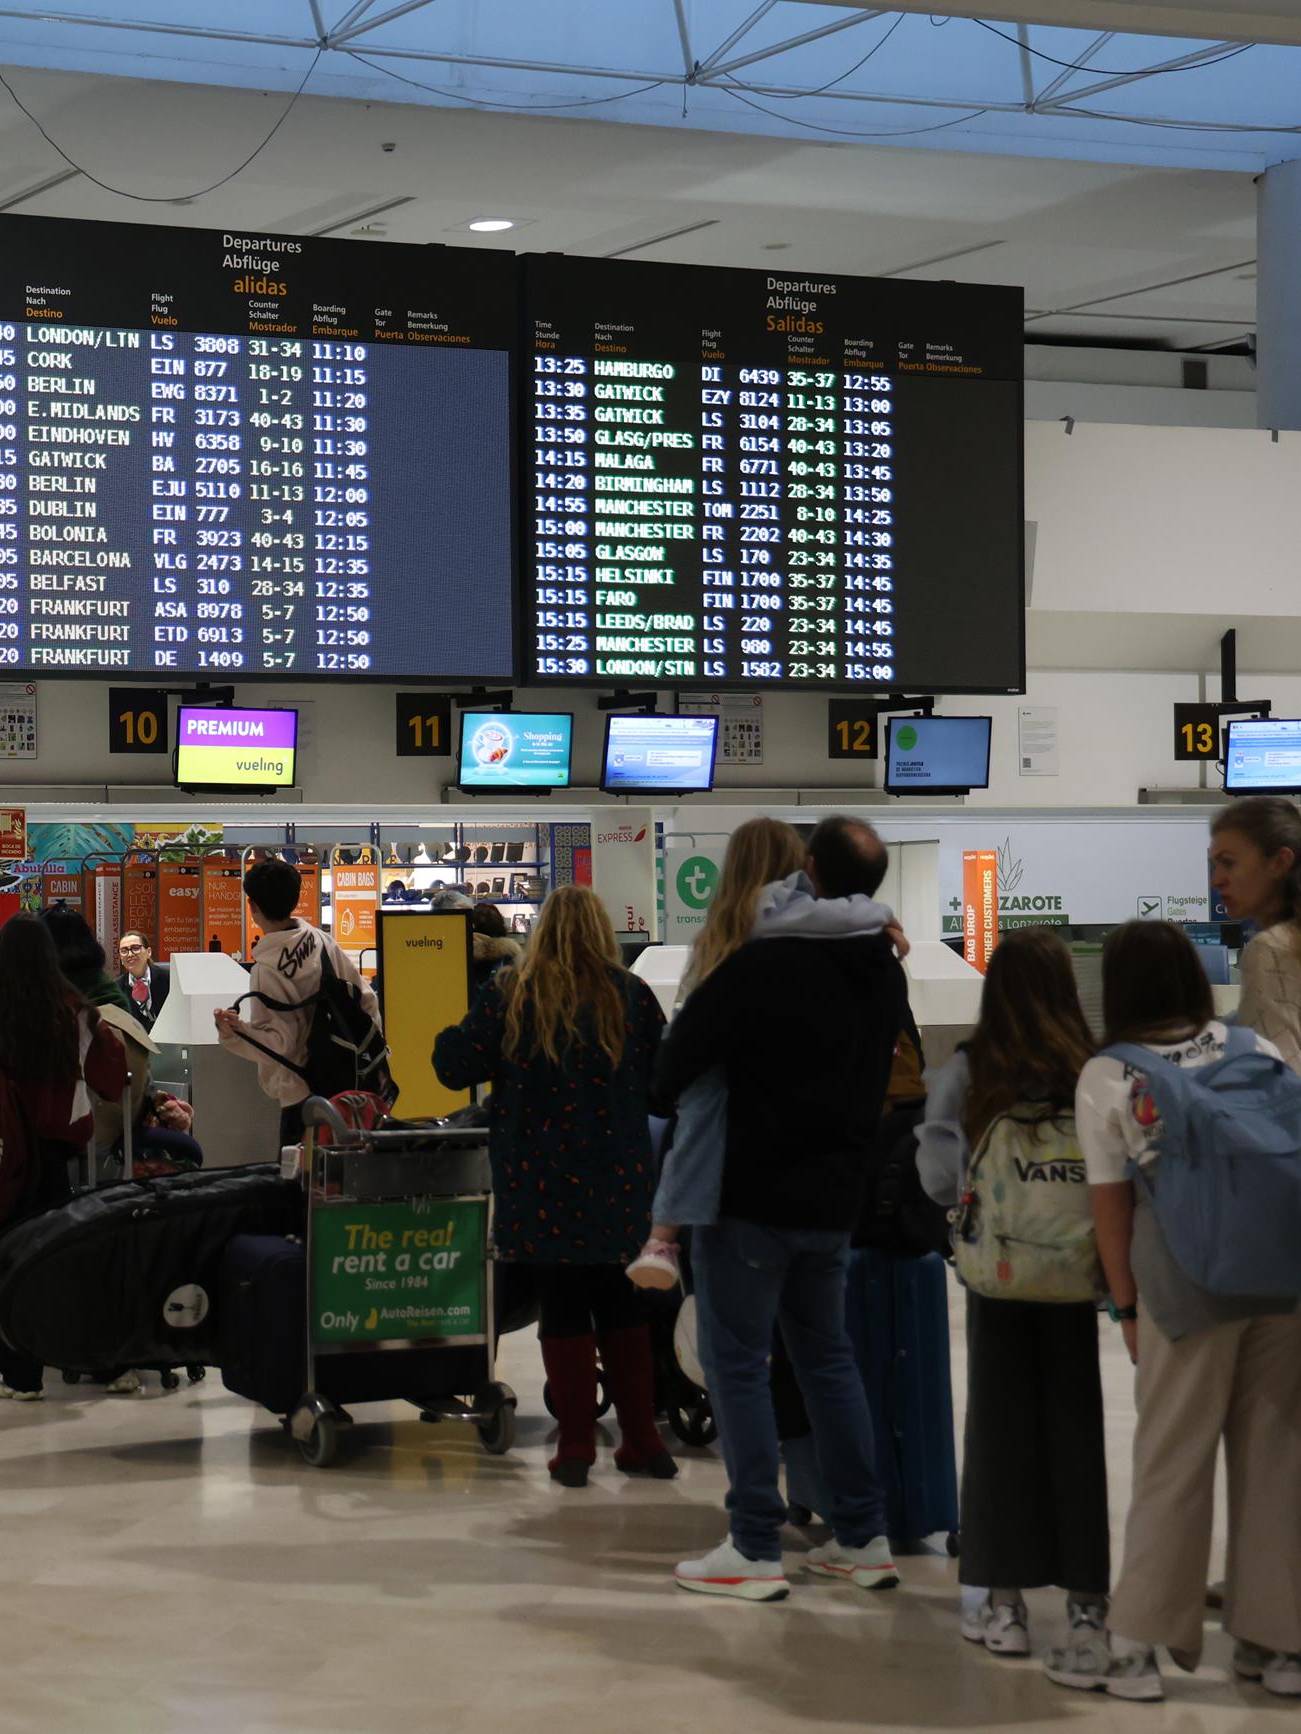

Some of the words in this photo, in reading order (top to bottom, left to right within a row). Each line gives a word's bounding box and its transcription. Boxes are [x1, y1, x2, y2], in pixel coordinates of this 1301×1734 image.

[223, 234, 302, 254] Departures
[222, 254, 280, 274] Abflüge
[234, 275, 287, 296] alidas
[766, 277, 837, 295] Departures
[766, 296, 817, 314] Abflüge
[766, 315, 824, 334] Salidas
[26, 326, 140, 349] LONDON/LTN
[150, 333, 174, 351] LS
[194, 336, 239, 355] 3808
[248, 339, 302, 358] 31-34
[312, 343, 366, 362] 11:10
[534, 356, 585, 375] 13:25
[594, 360, 674, 379] HAMBURGO
[701, 366, 721, 382] DI
[739, 368, 779, 385] 6439
[787, 371, 835, 388] 35-37
[843, 374, 891, 392] 12:55
[28, 425, 130, 446] EINDHOVEN
[151, 431, 175, 448] HV
[195, 433, 240, 451] 6358
[260, 436, 303, 454] 9-10
[313, 438, 367, 457] 11:30
[119, 711, 158, 744] 10
[187, 719, 264, 737] PREMIUM
[408, 715, 440, 747] 11
[523, 731, 563, 742] Shopping
[836, 720, 871, 750] 12
[1182, 723, 1213, 752] 13
[236, 757, 284, 775] vueling
[597, 832, 634, 844] EXPRESS
[50, 880, 78, 893] CABIN
[337, 872, 356, 886] CABIN
[358, 872, 375, 886] BAGS
[983, 870, 993, 929] CUSTOMERS
[1167, 896, 1208, 906] Flugsteige
[967, 904, 976, 935] DROP
[405, 936, 443, 950] vueling
[967, 938, 976, 962] BAG
[1013, 1157, 1085, 1183] VANS
[344, 1224, 394, 1250] The
[402, 1221, 455, 1247] real
[332, 1251, 387, 1274] rent
[395, 1254, 412, 1271] a
[419, 1251, 461, 1269] car
[364, 1277, 396, 1290] Since
[400, 1276, 429, 1289] 1984
[320, 1311, 360, 1333] Only
[379, 1305, 470, 1320] AutoReisen.com
